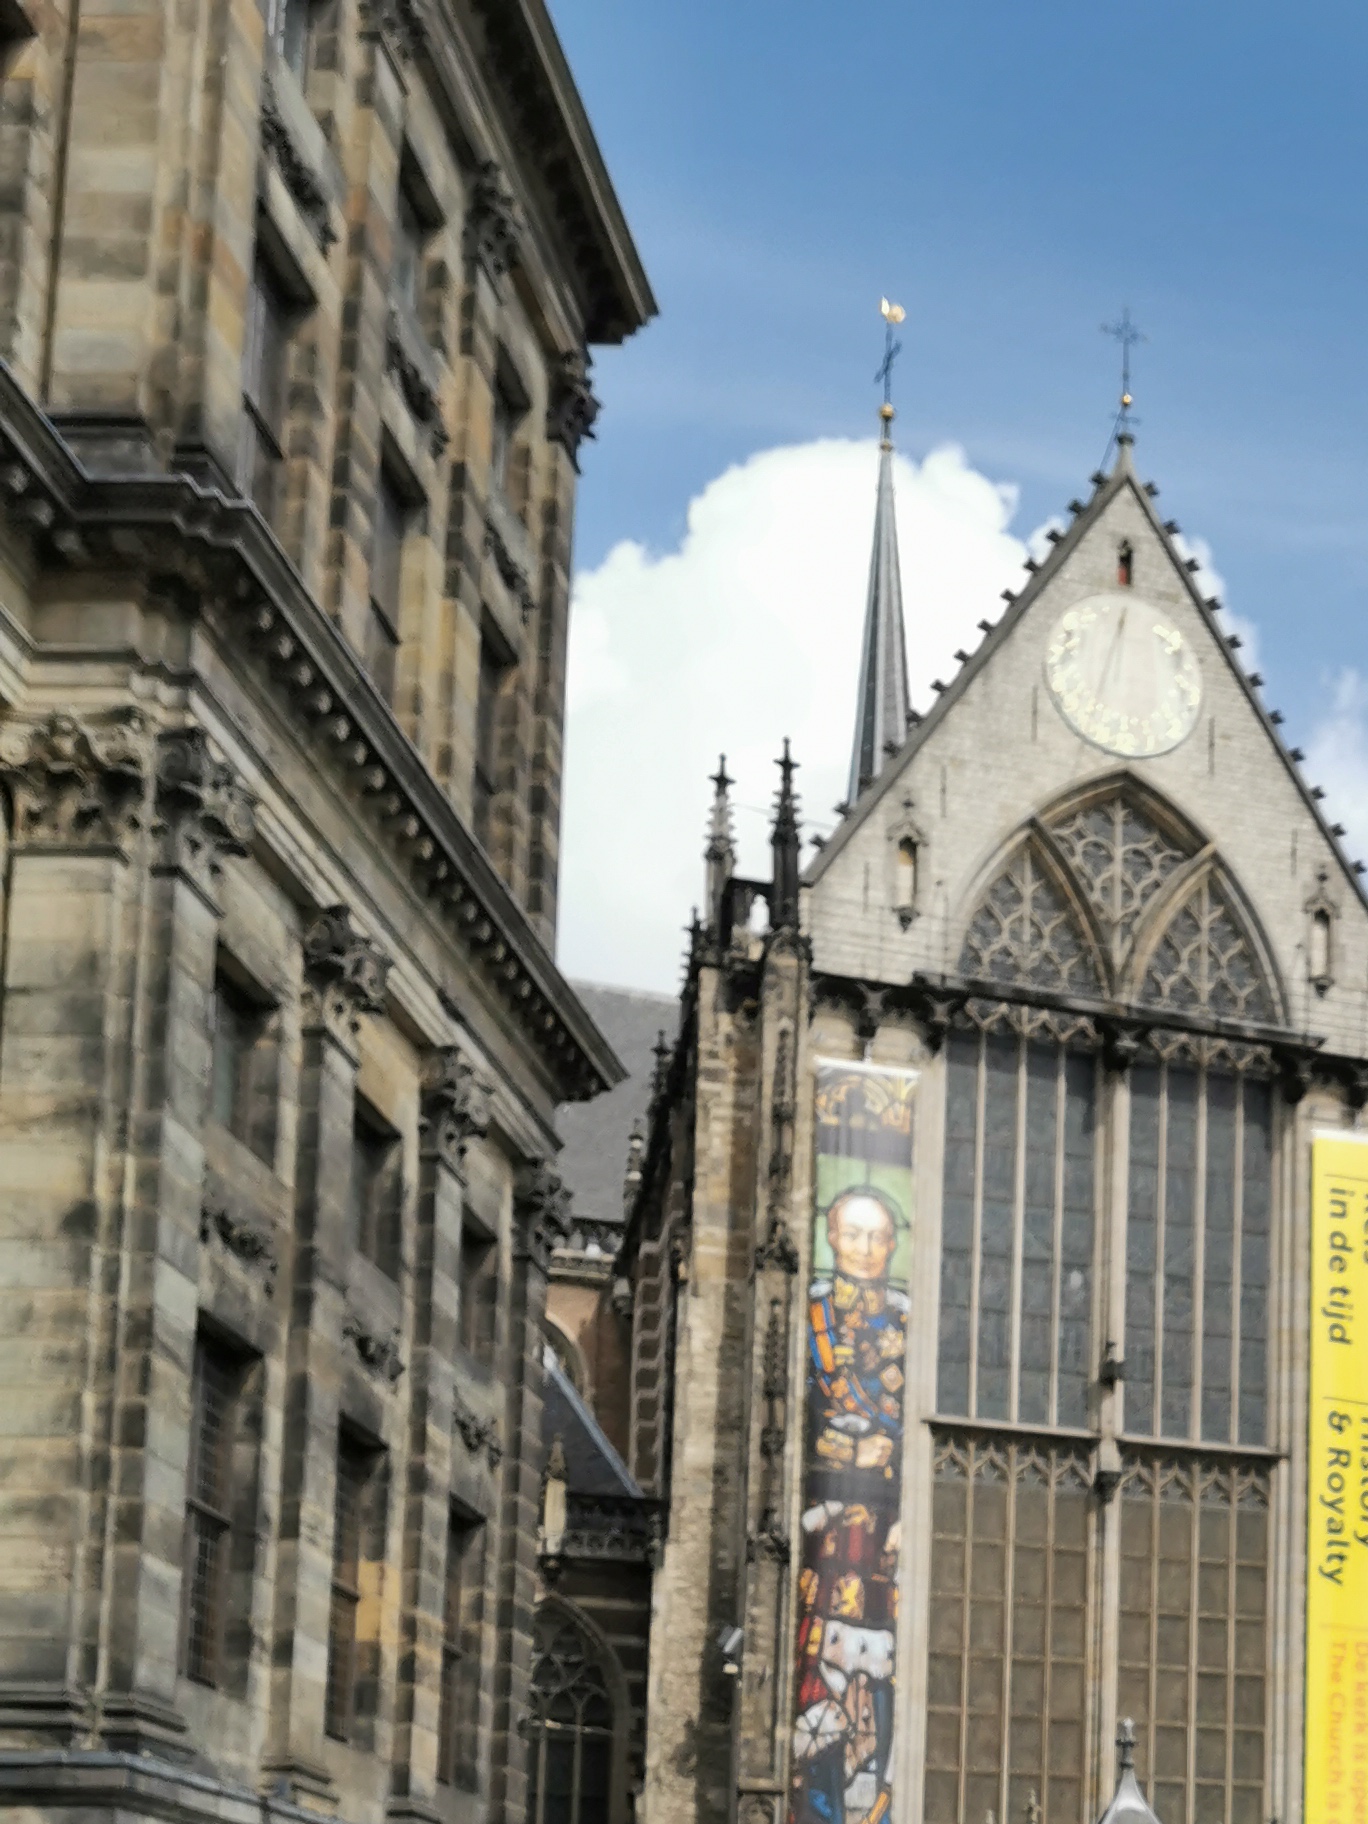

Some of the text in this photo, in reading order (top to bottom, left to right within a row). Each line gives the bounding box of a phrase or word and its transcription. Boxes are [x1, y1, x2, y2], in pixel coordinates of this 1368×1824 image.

[1321, 1187, 1355, 1346] in de tijd
[1318, 1410, 1352, 1586] & Royalty
[1329, 1642, 1347, 1684] The
